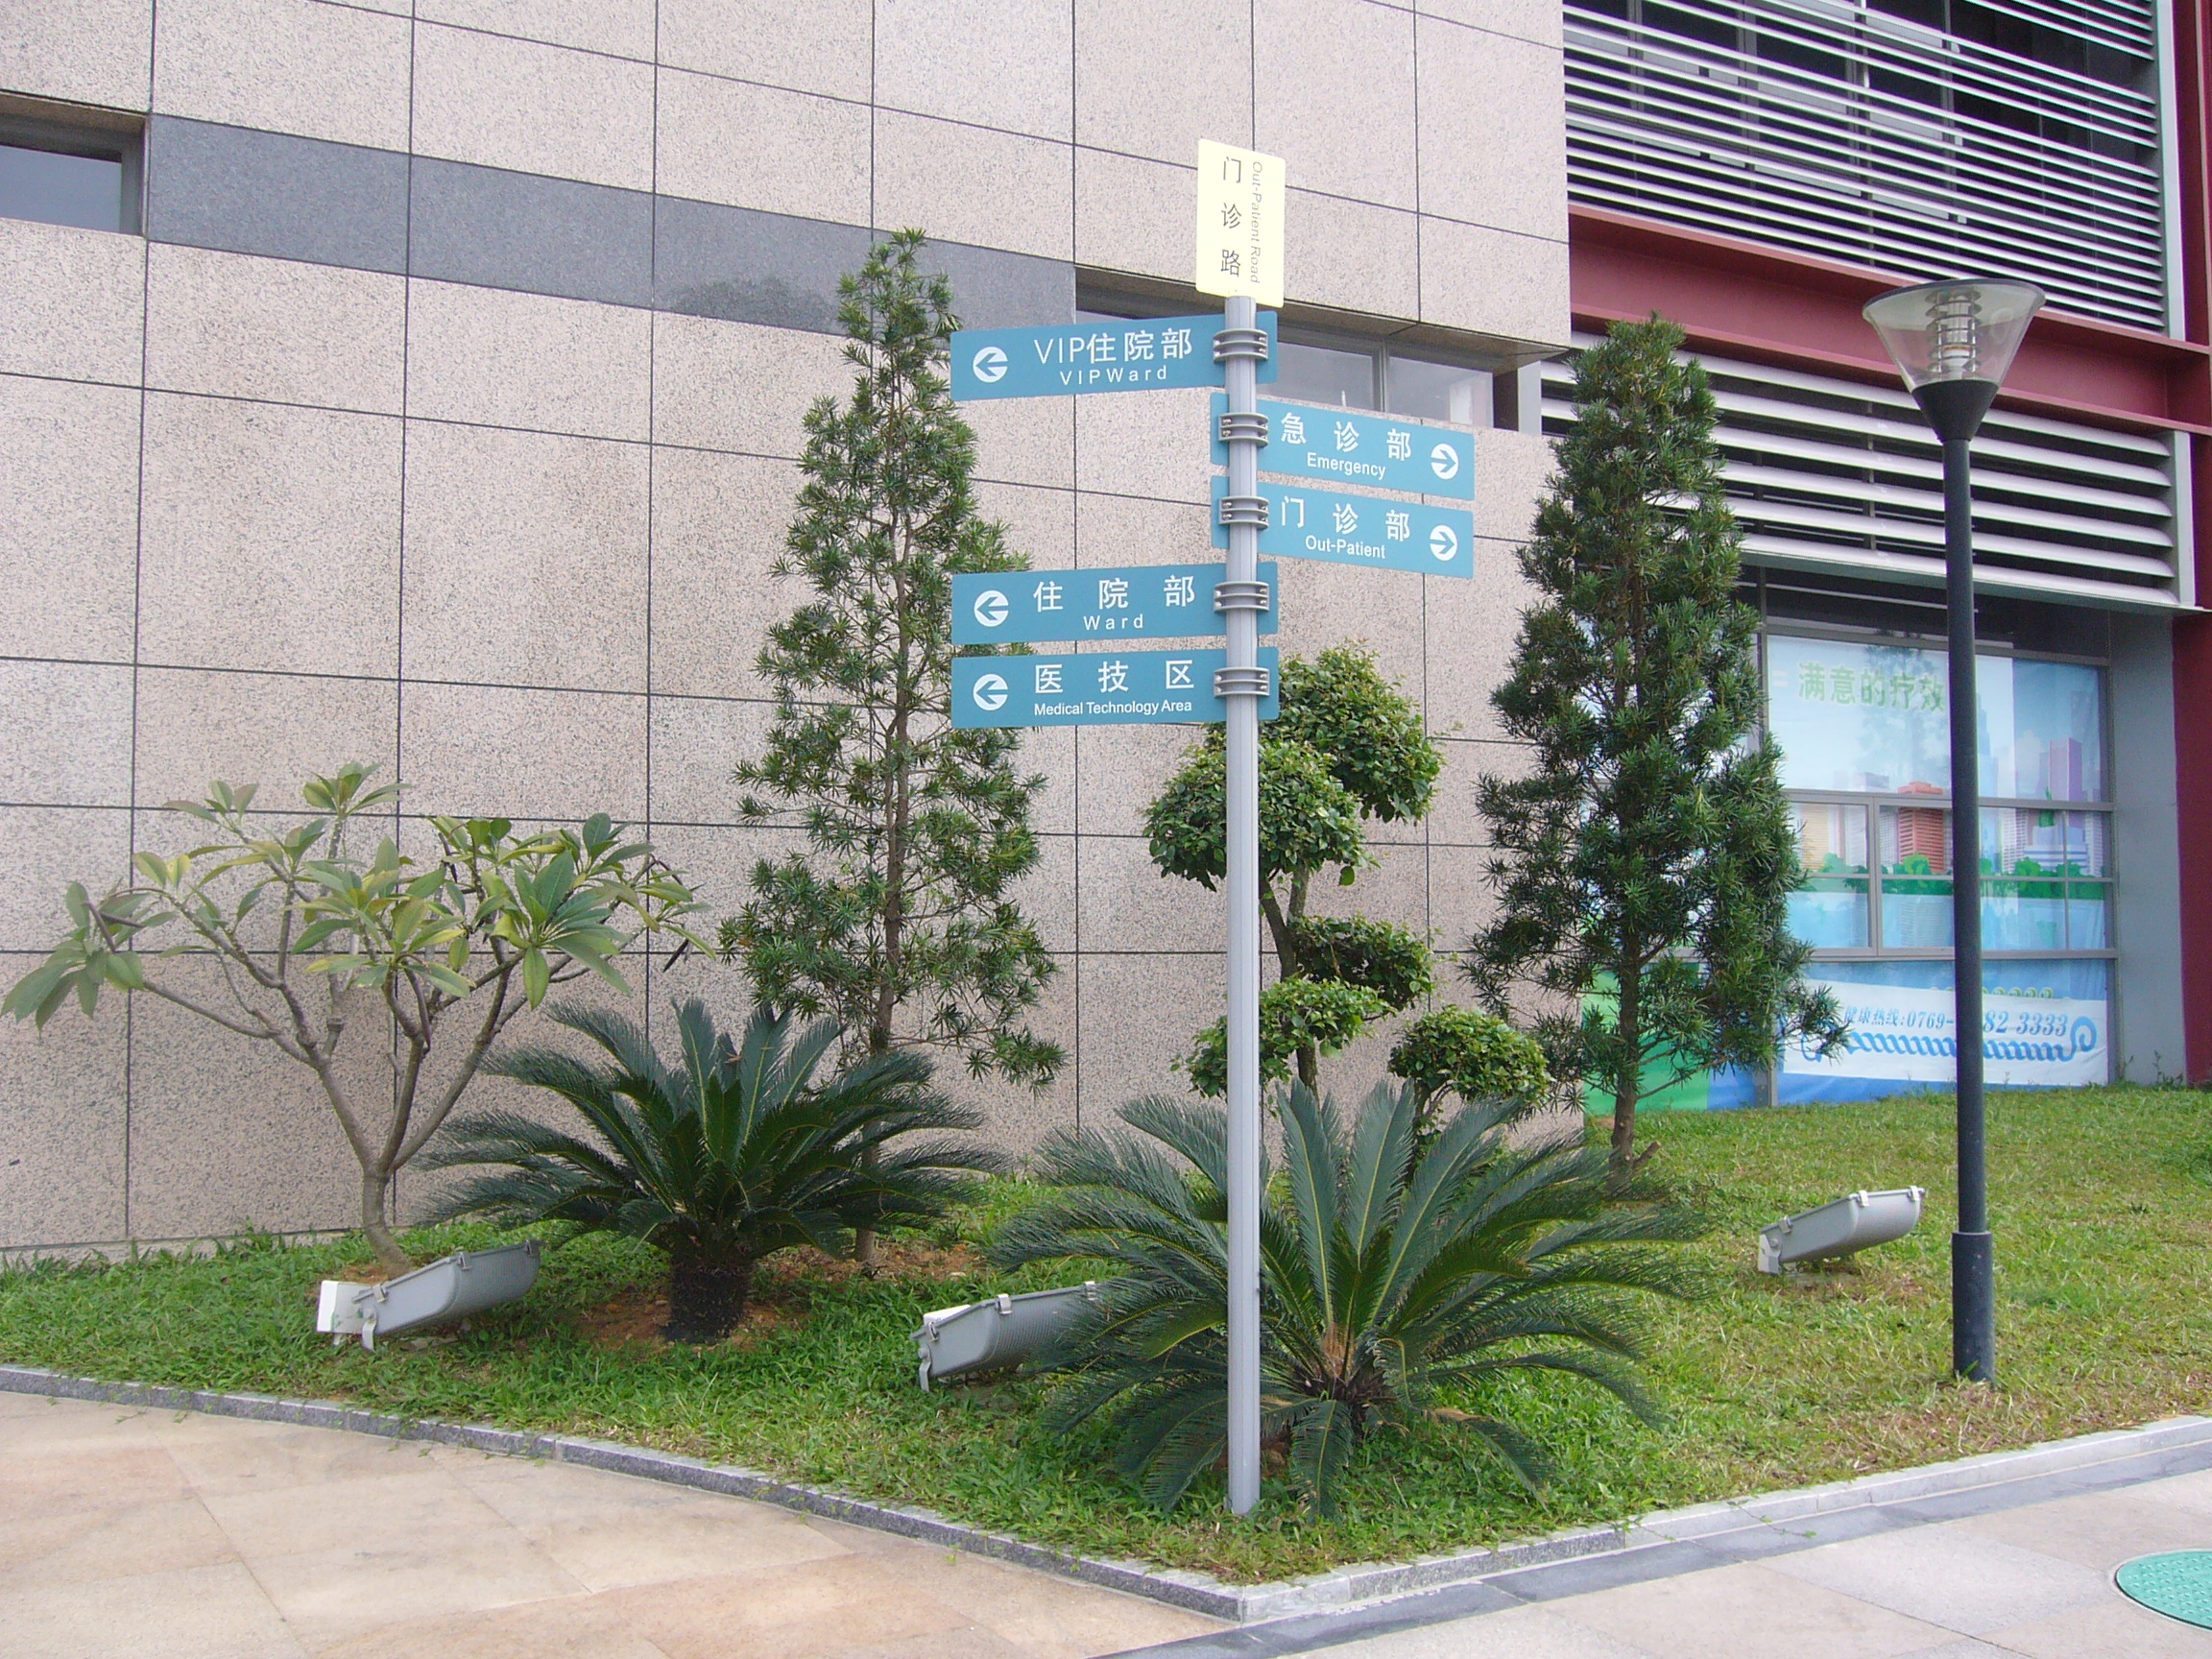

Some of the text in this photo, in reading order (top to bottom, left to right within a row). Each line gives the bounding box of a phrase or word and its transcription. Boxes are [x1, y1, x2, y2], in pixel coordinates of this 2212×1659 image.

[1220, 156, 1242, 277] 门诊路
[1250, 161, 1263, 284] Out-Patient Road
[1033, 327, 1192, 365] VIP住院部
[1280, 412, 1412, 462] 急诊部
[1307, 451, 1386, 481] Emergency
[1281, 495, 1411, 542] 门诊部
[1305, 535, 1386, 560] Out-Patient
[1033, 574, 1196, 613] 住院部
[1083, 613, 1143, 631] Ward
[1034, 659, 1194, 694] 医技区
[1798, 661, 1946, 712] 满意的疗效
[1034, 699, 1192, 716] Medical Technology Area
